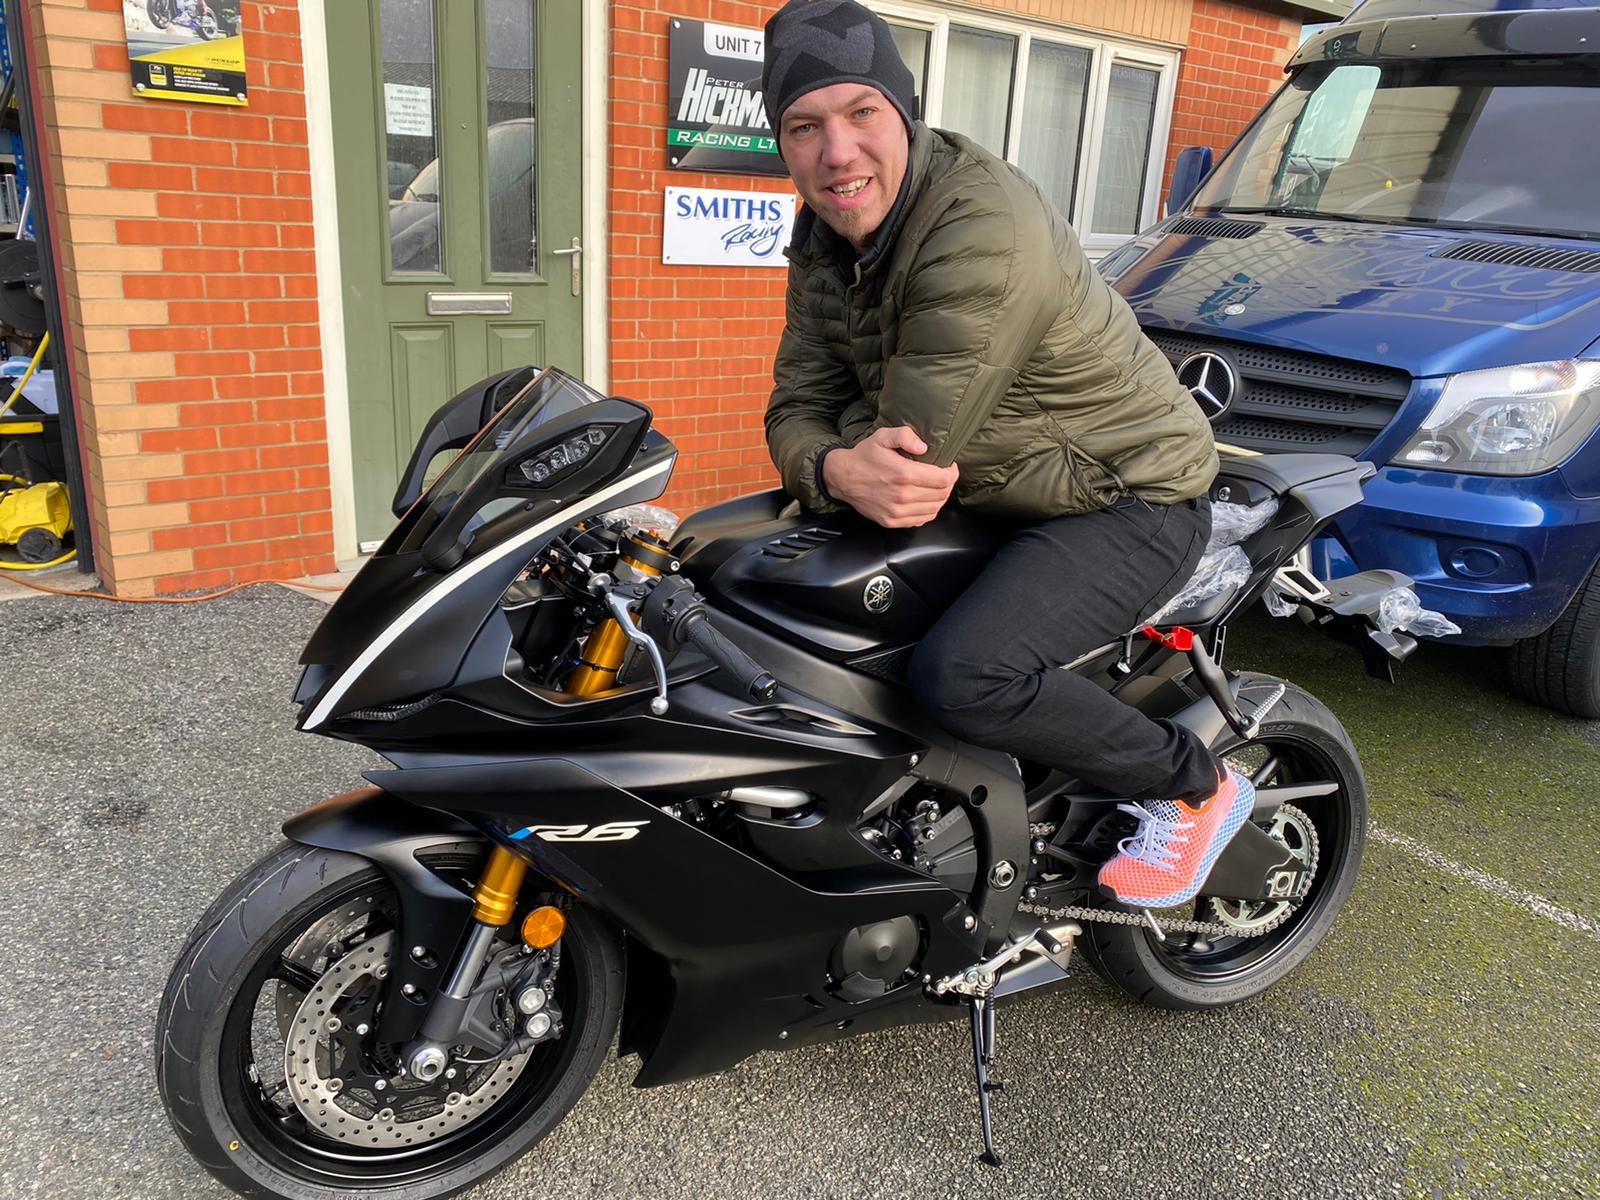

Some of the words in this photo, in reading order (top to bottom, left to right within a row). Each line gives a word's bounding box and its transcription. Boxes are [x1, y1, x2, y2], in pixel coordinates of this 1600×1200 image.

[715, 34, 750, 53] UNIT
[754, 40, 762, 55] 7
[705, 76, 744, 88] PETER
[676, 131, 751, 148] RACING
[757, 138, 776, 150] LT
[676, 194, 781, 222] SMITHS
[720, 221, 784, 257] Racing
[507, 820, 651, 842] R6
